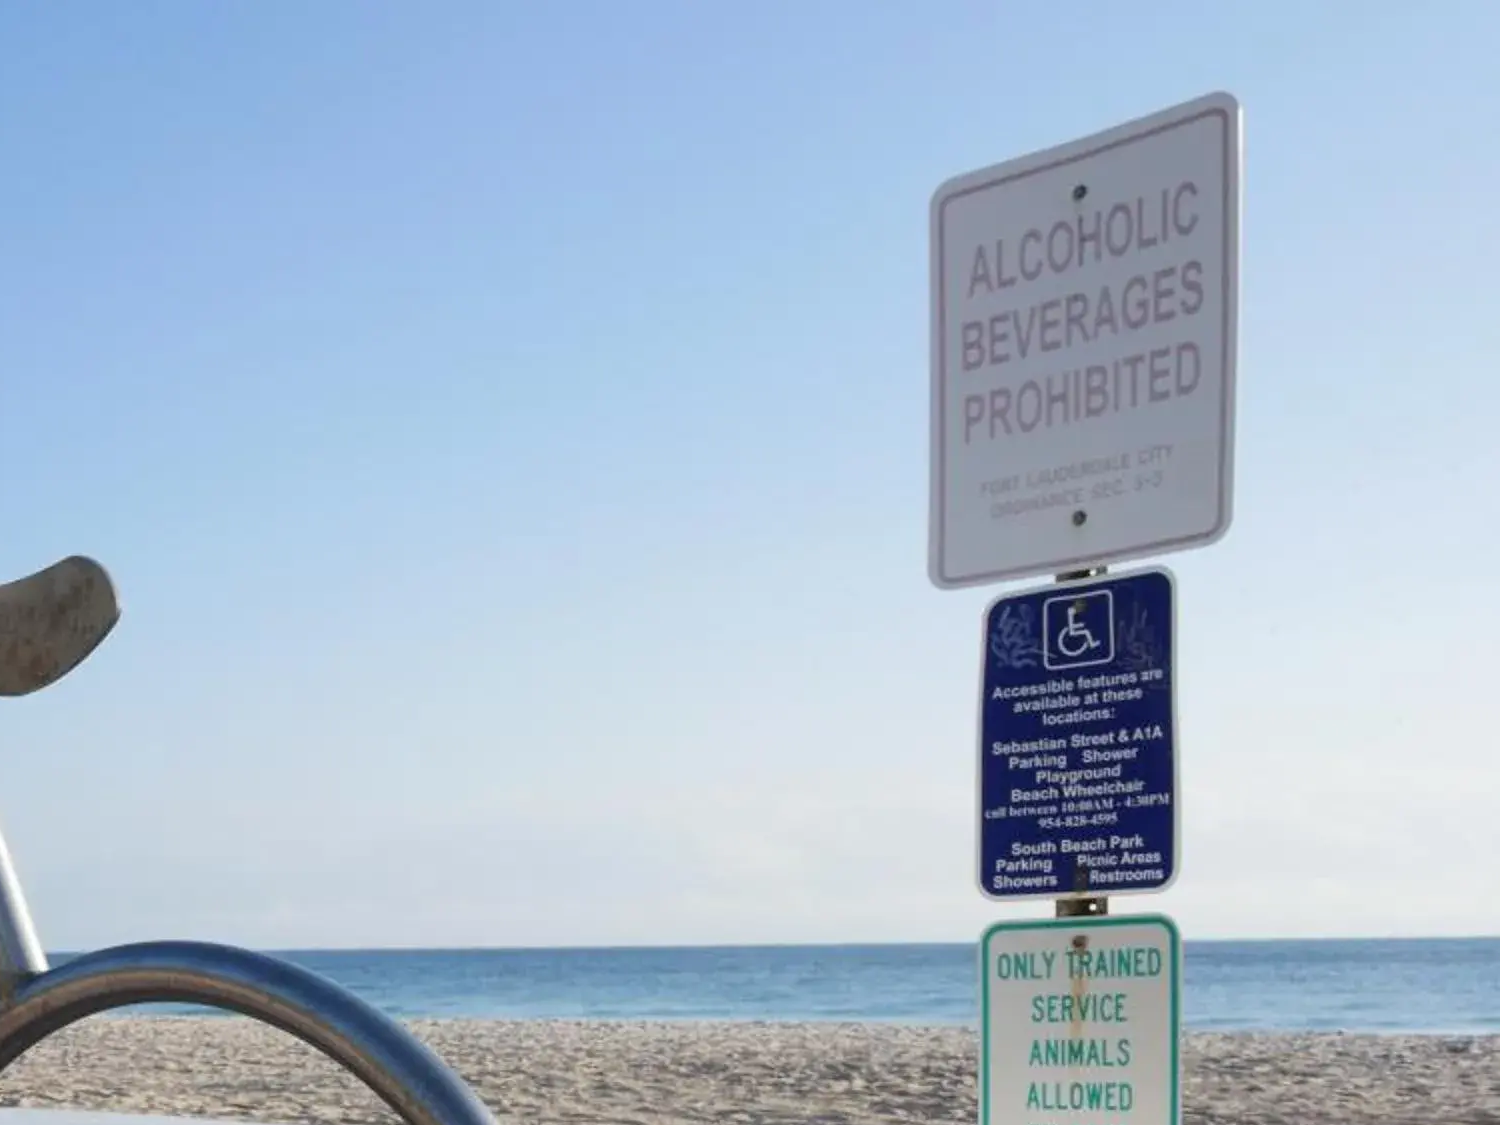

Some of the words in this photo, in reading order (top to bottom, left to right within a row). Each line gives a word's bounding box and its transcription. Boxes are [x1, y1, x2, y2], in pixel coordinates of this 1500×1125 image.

[967, 181, 1199, 298] ALCOHOLIC
[961, 260, 1204, 371] BEVERAGES
[964, 342, 1200, 443] PROHIBITED
[992, 679, 1073, 699] Accessible
[1078, 672, 1137, 689] features
[1140, 669, 1163, 680] are
[1013, 693, 1080, 713] available
[1084, 692, 1099, 704] at
[1102, 687, 1143, 702] these
[1043, 708, 1115, 725] locations:
[992, 737, 1066, 755] Sebastian
[1070, 731, 1114, 748] Street
[1118, 729, 1129, 742] &
[1132, 725, 1163, 740] A1A
[1008, 754, 1067, 770] Parking
[1081, 747, 1139, 763] Shower
[1036, 764, 1121, 784] Playground
[1011, 787, 1058, 802] Beach
[1062, 780, 1145, 797] Wheelchair
[984, 808, 1006, 819] call
[1009, 804, 1057, 817] between
[1011, 841, 1056, 856] South
[1060, 838, 1107, 853] Beach
[1110, 834, 1144, 849] Park
[995, 858, 1052, 873] Parking
[1077, 854, 1118, 867] Picnic
[1121, 851, 1162, 864] Areas
[993, 873, 1058, 889] Showers
[1089, 868, 1165, 884] Restrooms
[997, 952, 1057, 980] ONLY
[1065, 947, 1162, 979] TRAINED
[1031, 993, 1129, 1023] SERVICE
[1028, 1038, 1131, 1067] ANIMALS
[1026, 1081, 1134, 1111] ALLOWED
